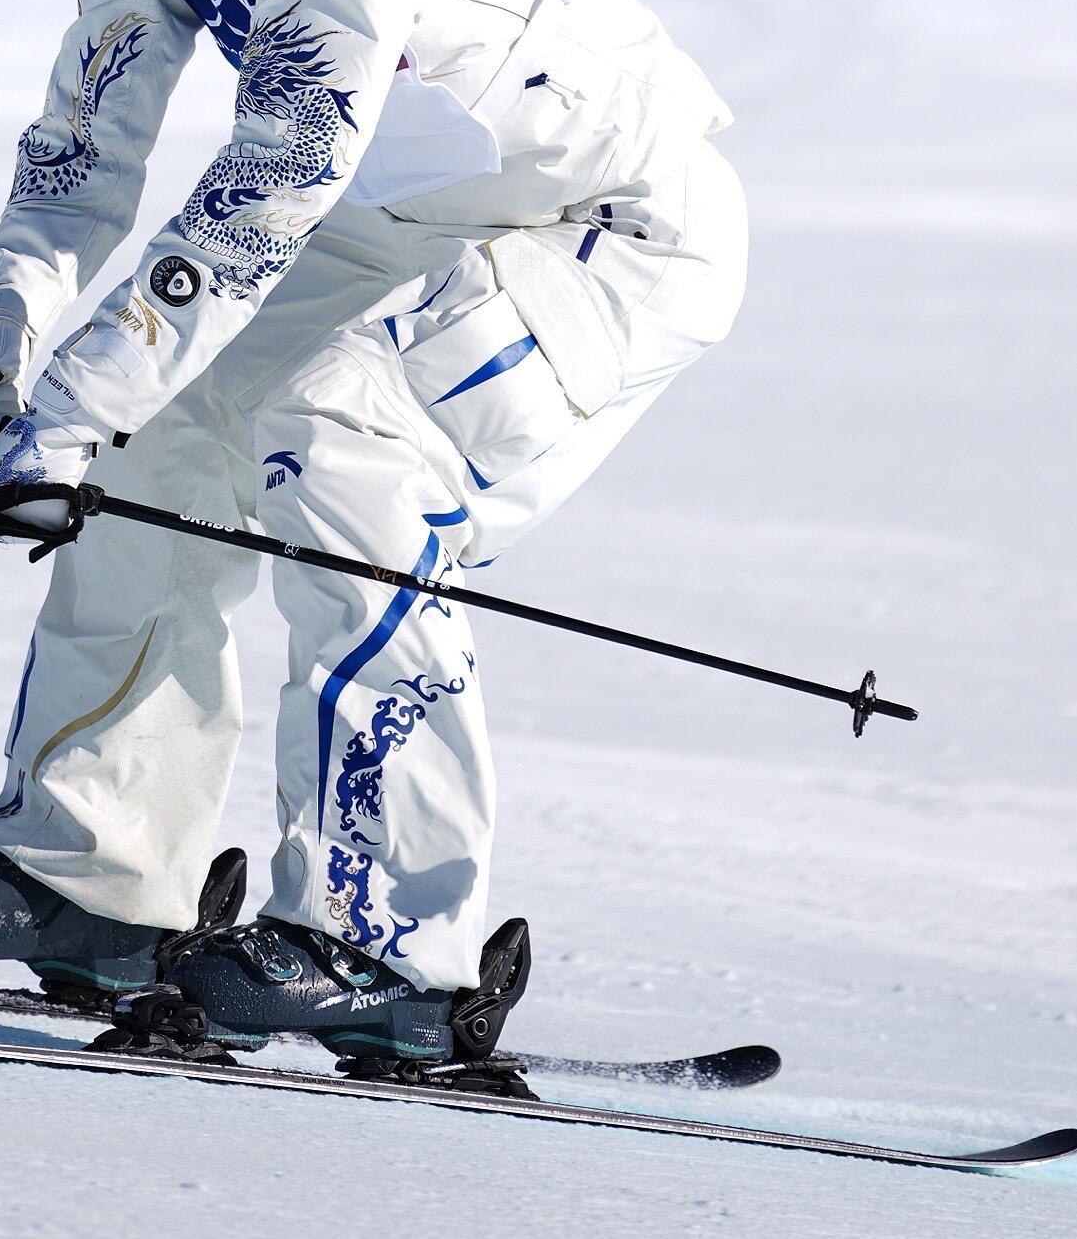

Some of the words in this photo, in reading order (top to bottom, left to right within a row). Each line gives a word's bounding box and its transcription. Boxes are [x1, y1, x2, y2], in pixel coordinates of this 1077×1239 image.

[114, 307, 144, 333] ANTA
[46, 373, 75, 401] EILEEN
[265, 467, 286, 492] ANTA
[350, 983, 410, 1012] ATOMIC
